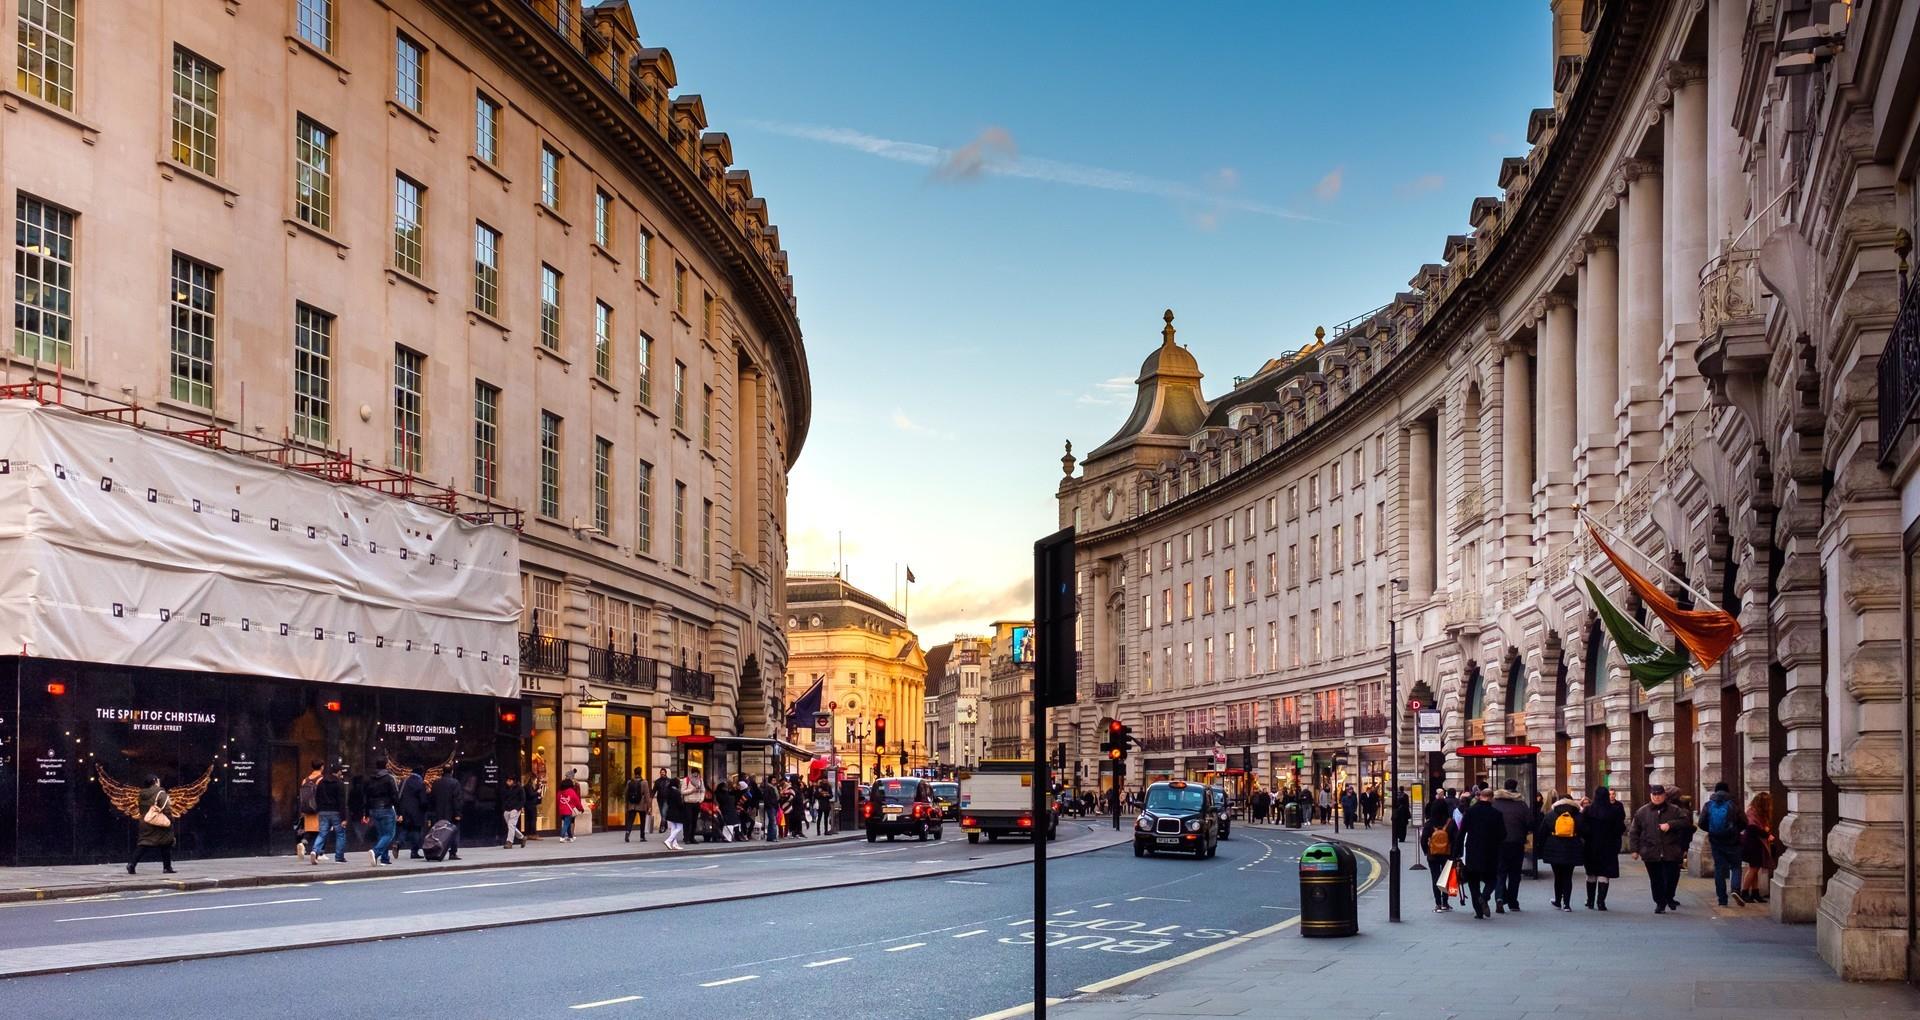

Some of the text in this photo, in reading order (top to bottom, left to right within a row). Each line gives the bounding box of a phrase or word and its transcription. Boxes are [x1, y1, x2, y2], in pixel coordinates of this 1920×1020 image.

[1412, 701, 1420, 709] D
[96, 708, 115, 719] THE
[150, 711, 163, 720] OF
[164, 711, 216, 723] CHRISTMAS
[385, 723, 396, 732] THE
[416, 725, 424, 733] OF
[424, 725, 456, 735] CHRISTMAS
[1045, 919, 1239, 939] STOP
[998, 931, 1174, 954] BUS
